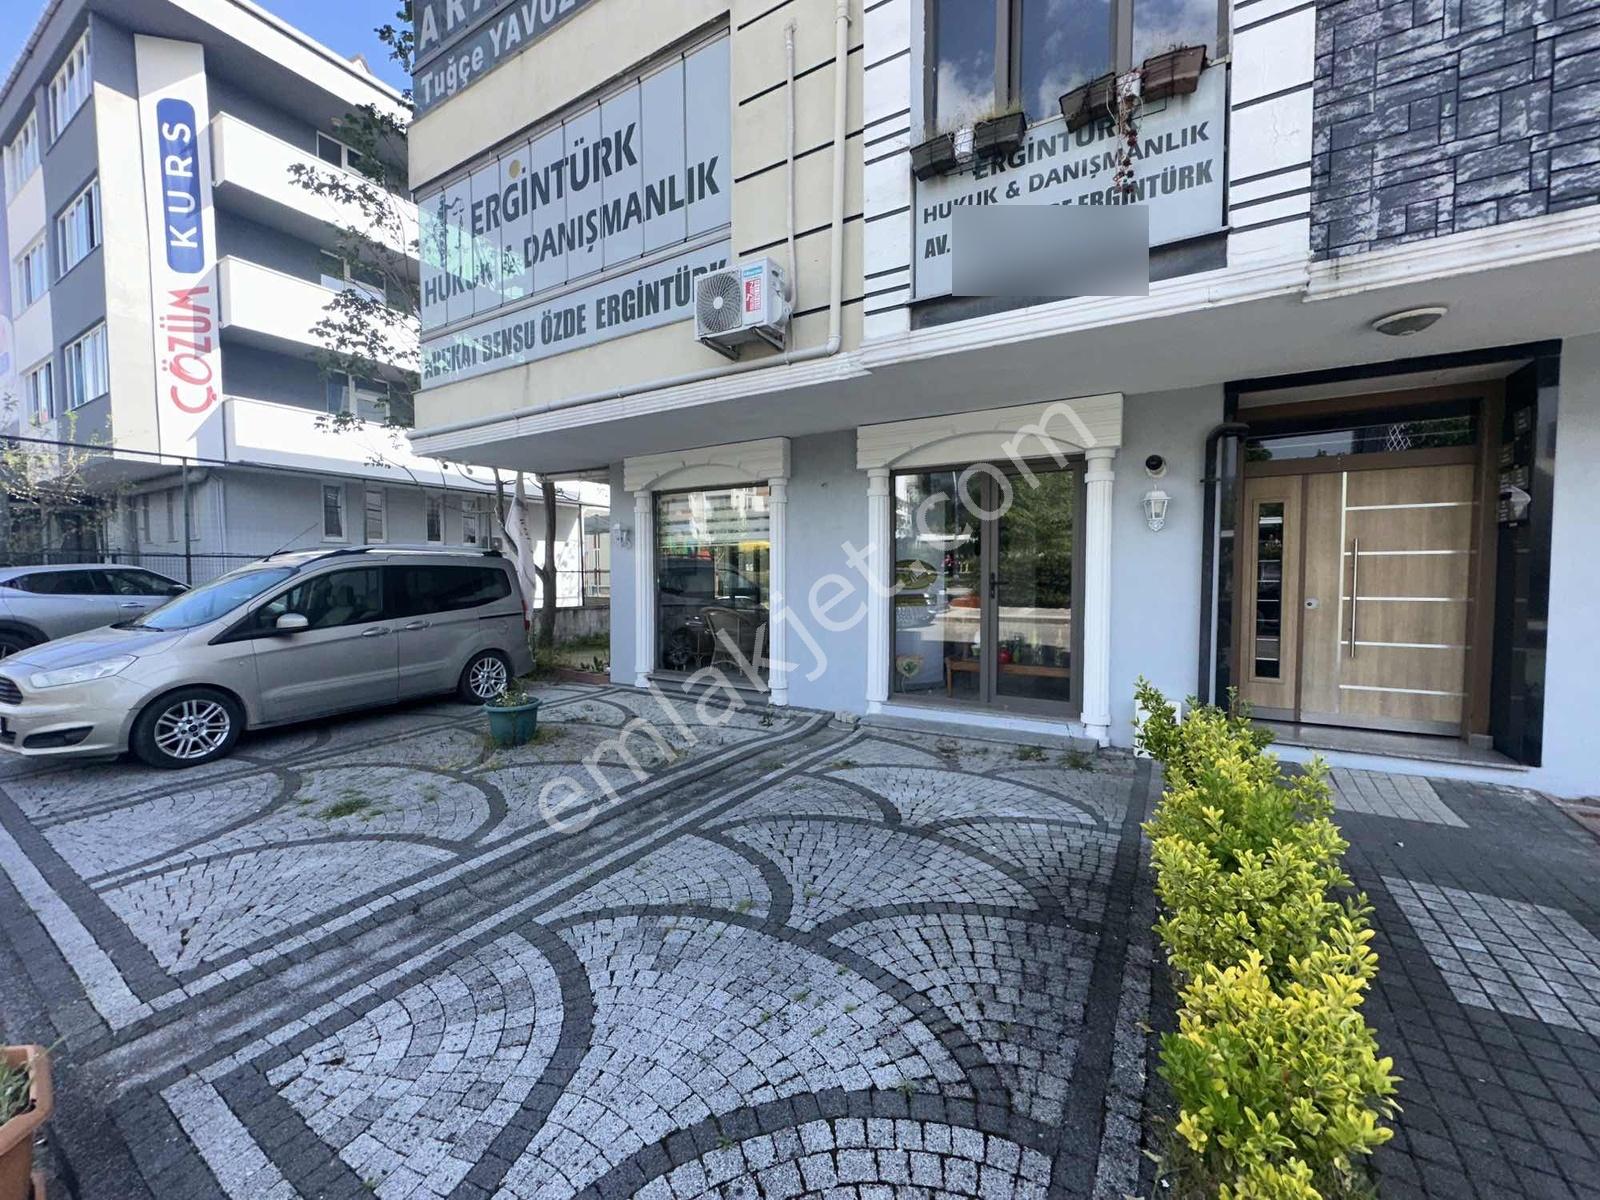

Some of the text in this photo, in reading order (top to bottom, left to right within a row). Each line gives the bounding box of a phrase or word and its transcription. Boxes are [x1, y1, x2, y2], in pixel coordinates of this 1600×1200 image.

[420, 0, 480, 50] AR
[421, 45, 484, 104] Tuğçe
[471, 122, 638, 236] ERGİNTÜRK
[1006, 181, 1020, 199] &
[1028, 121, 1209, 192] DANIŞMANLIK
[523, 156, 720, 268] DANIŞMANLIK
[924, 234, 951, 259] AV.
[160, 122, 217, 413] ÇÖZÜM KURS
[482, 320, 535, 362] BENSU
[541, 303, 587, 345] ÖZDE
[596, 259, 727, 329] ERGİNTÜ
